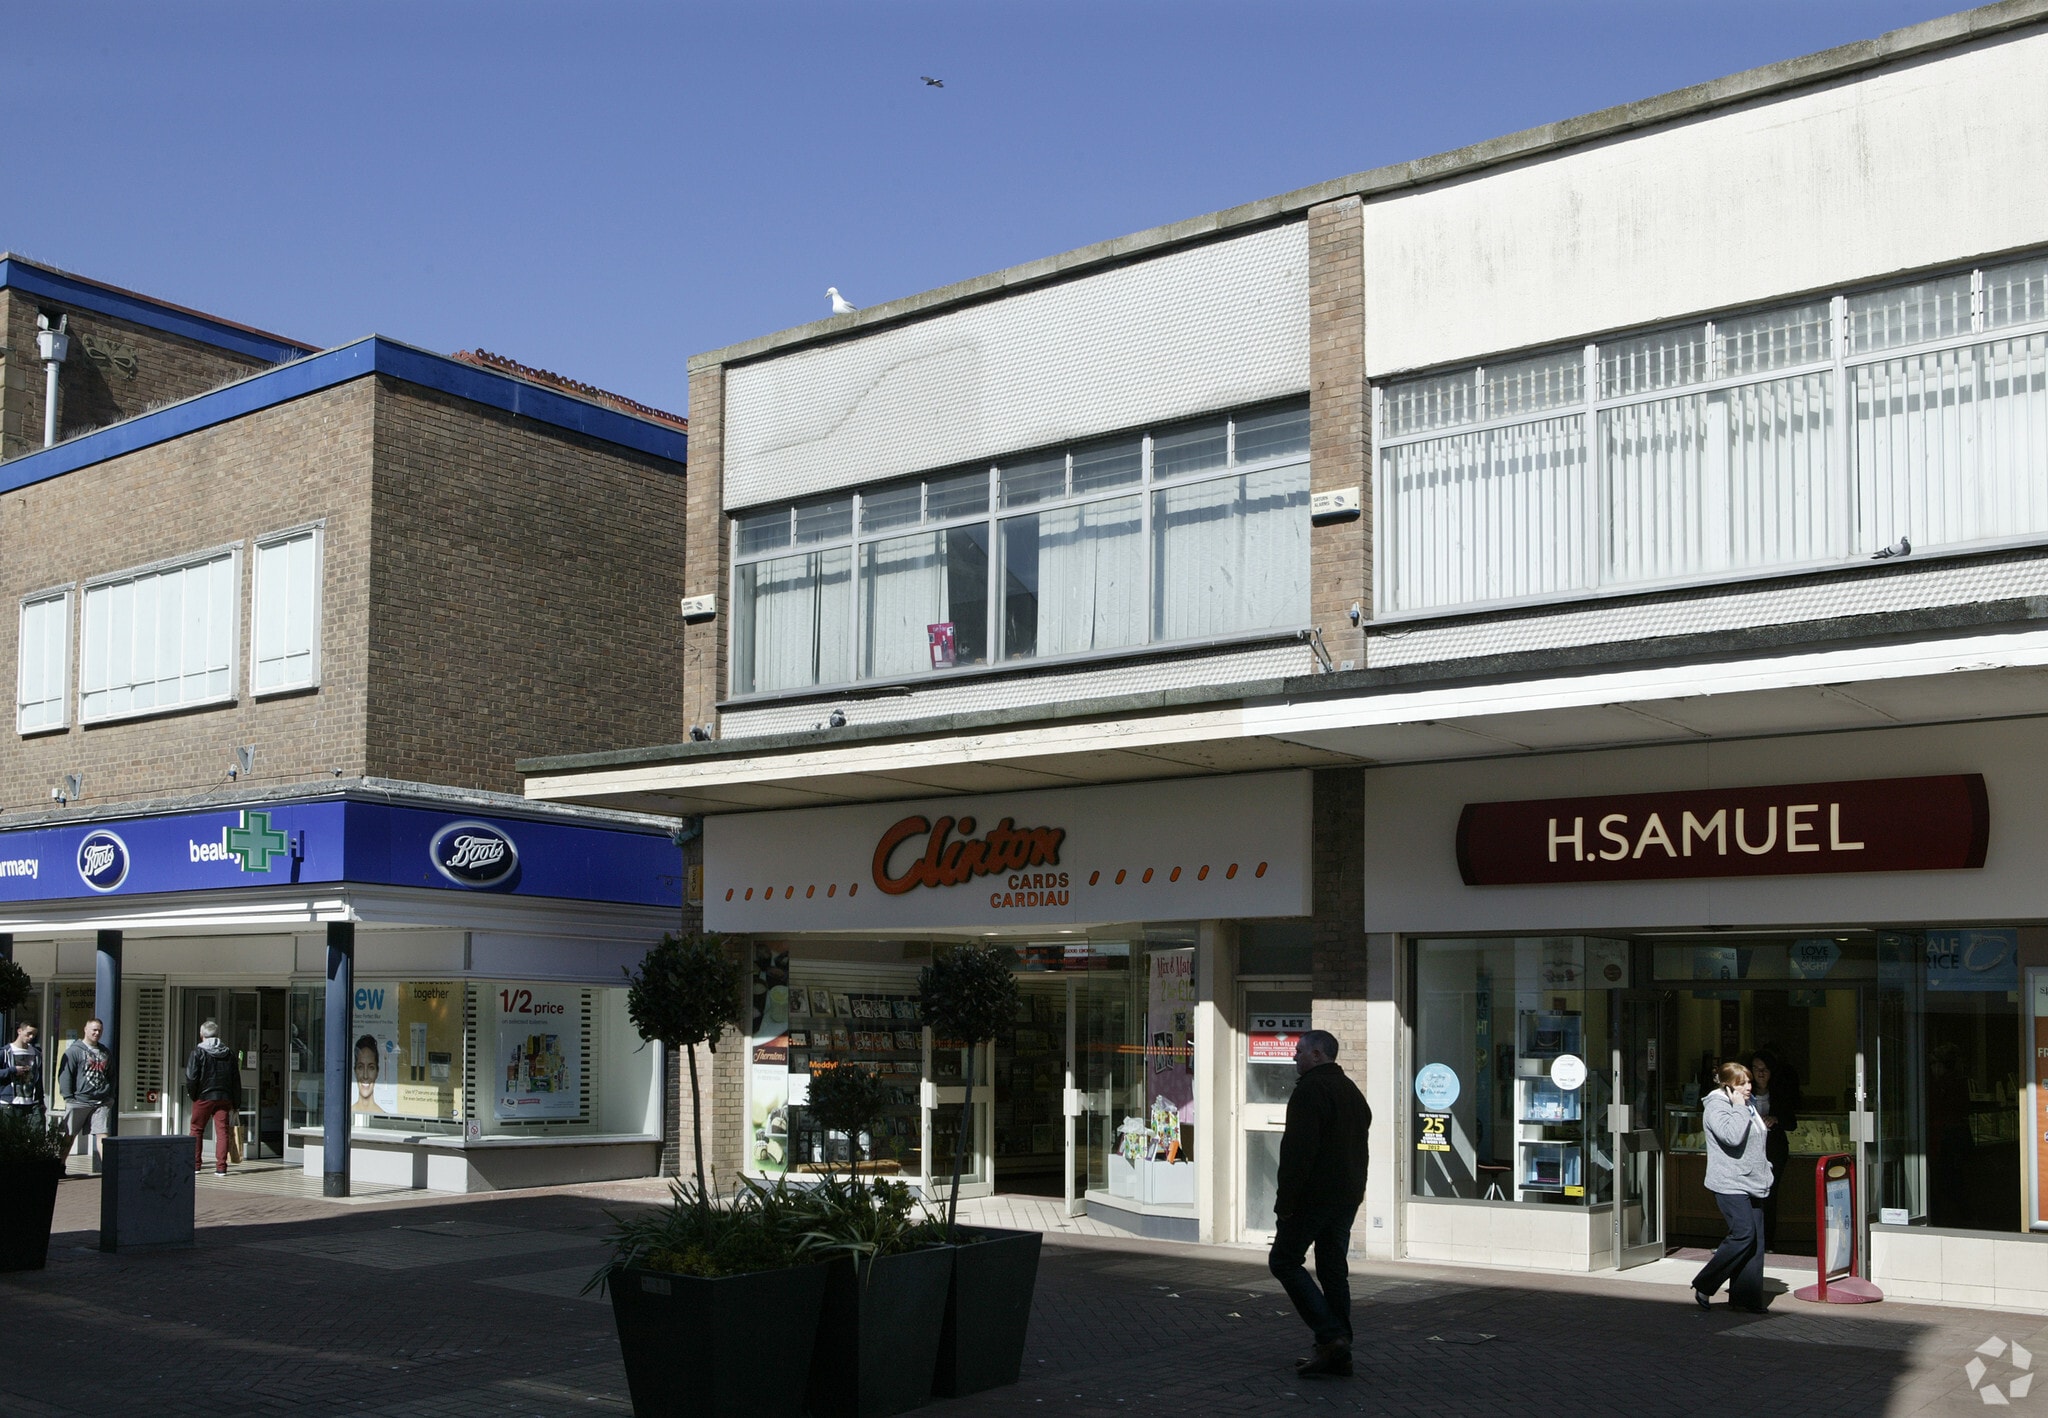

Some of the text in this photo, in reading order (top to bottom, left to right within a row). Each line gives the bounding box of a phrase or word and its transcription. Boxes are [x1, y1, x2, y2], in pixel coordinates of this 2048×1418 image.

[1548, 803, 1865, 863] H.SAMUEL
[83, 844, 115, 877] Boots
[446, 835, 504, 870] Boots
[872, 814, 1066, 895] Clinton
[1008, 872, 1070, 890] CARDS
[990, 890, 1070, 909] CARDIAU
[1801, 945, 1829, 956] LOVE
[1926, 936, 1960, 954] ALF
[1801, 961, 1828, 970] SIGHT
[354, 988, 385, 1010] ew
[413, 987, 449, 1001] together
[500, 989, 564, 1016] 1/2 price
[1422, 1117, 1445, 1134] 25
